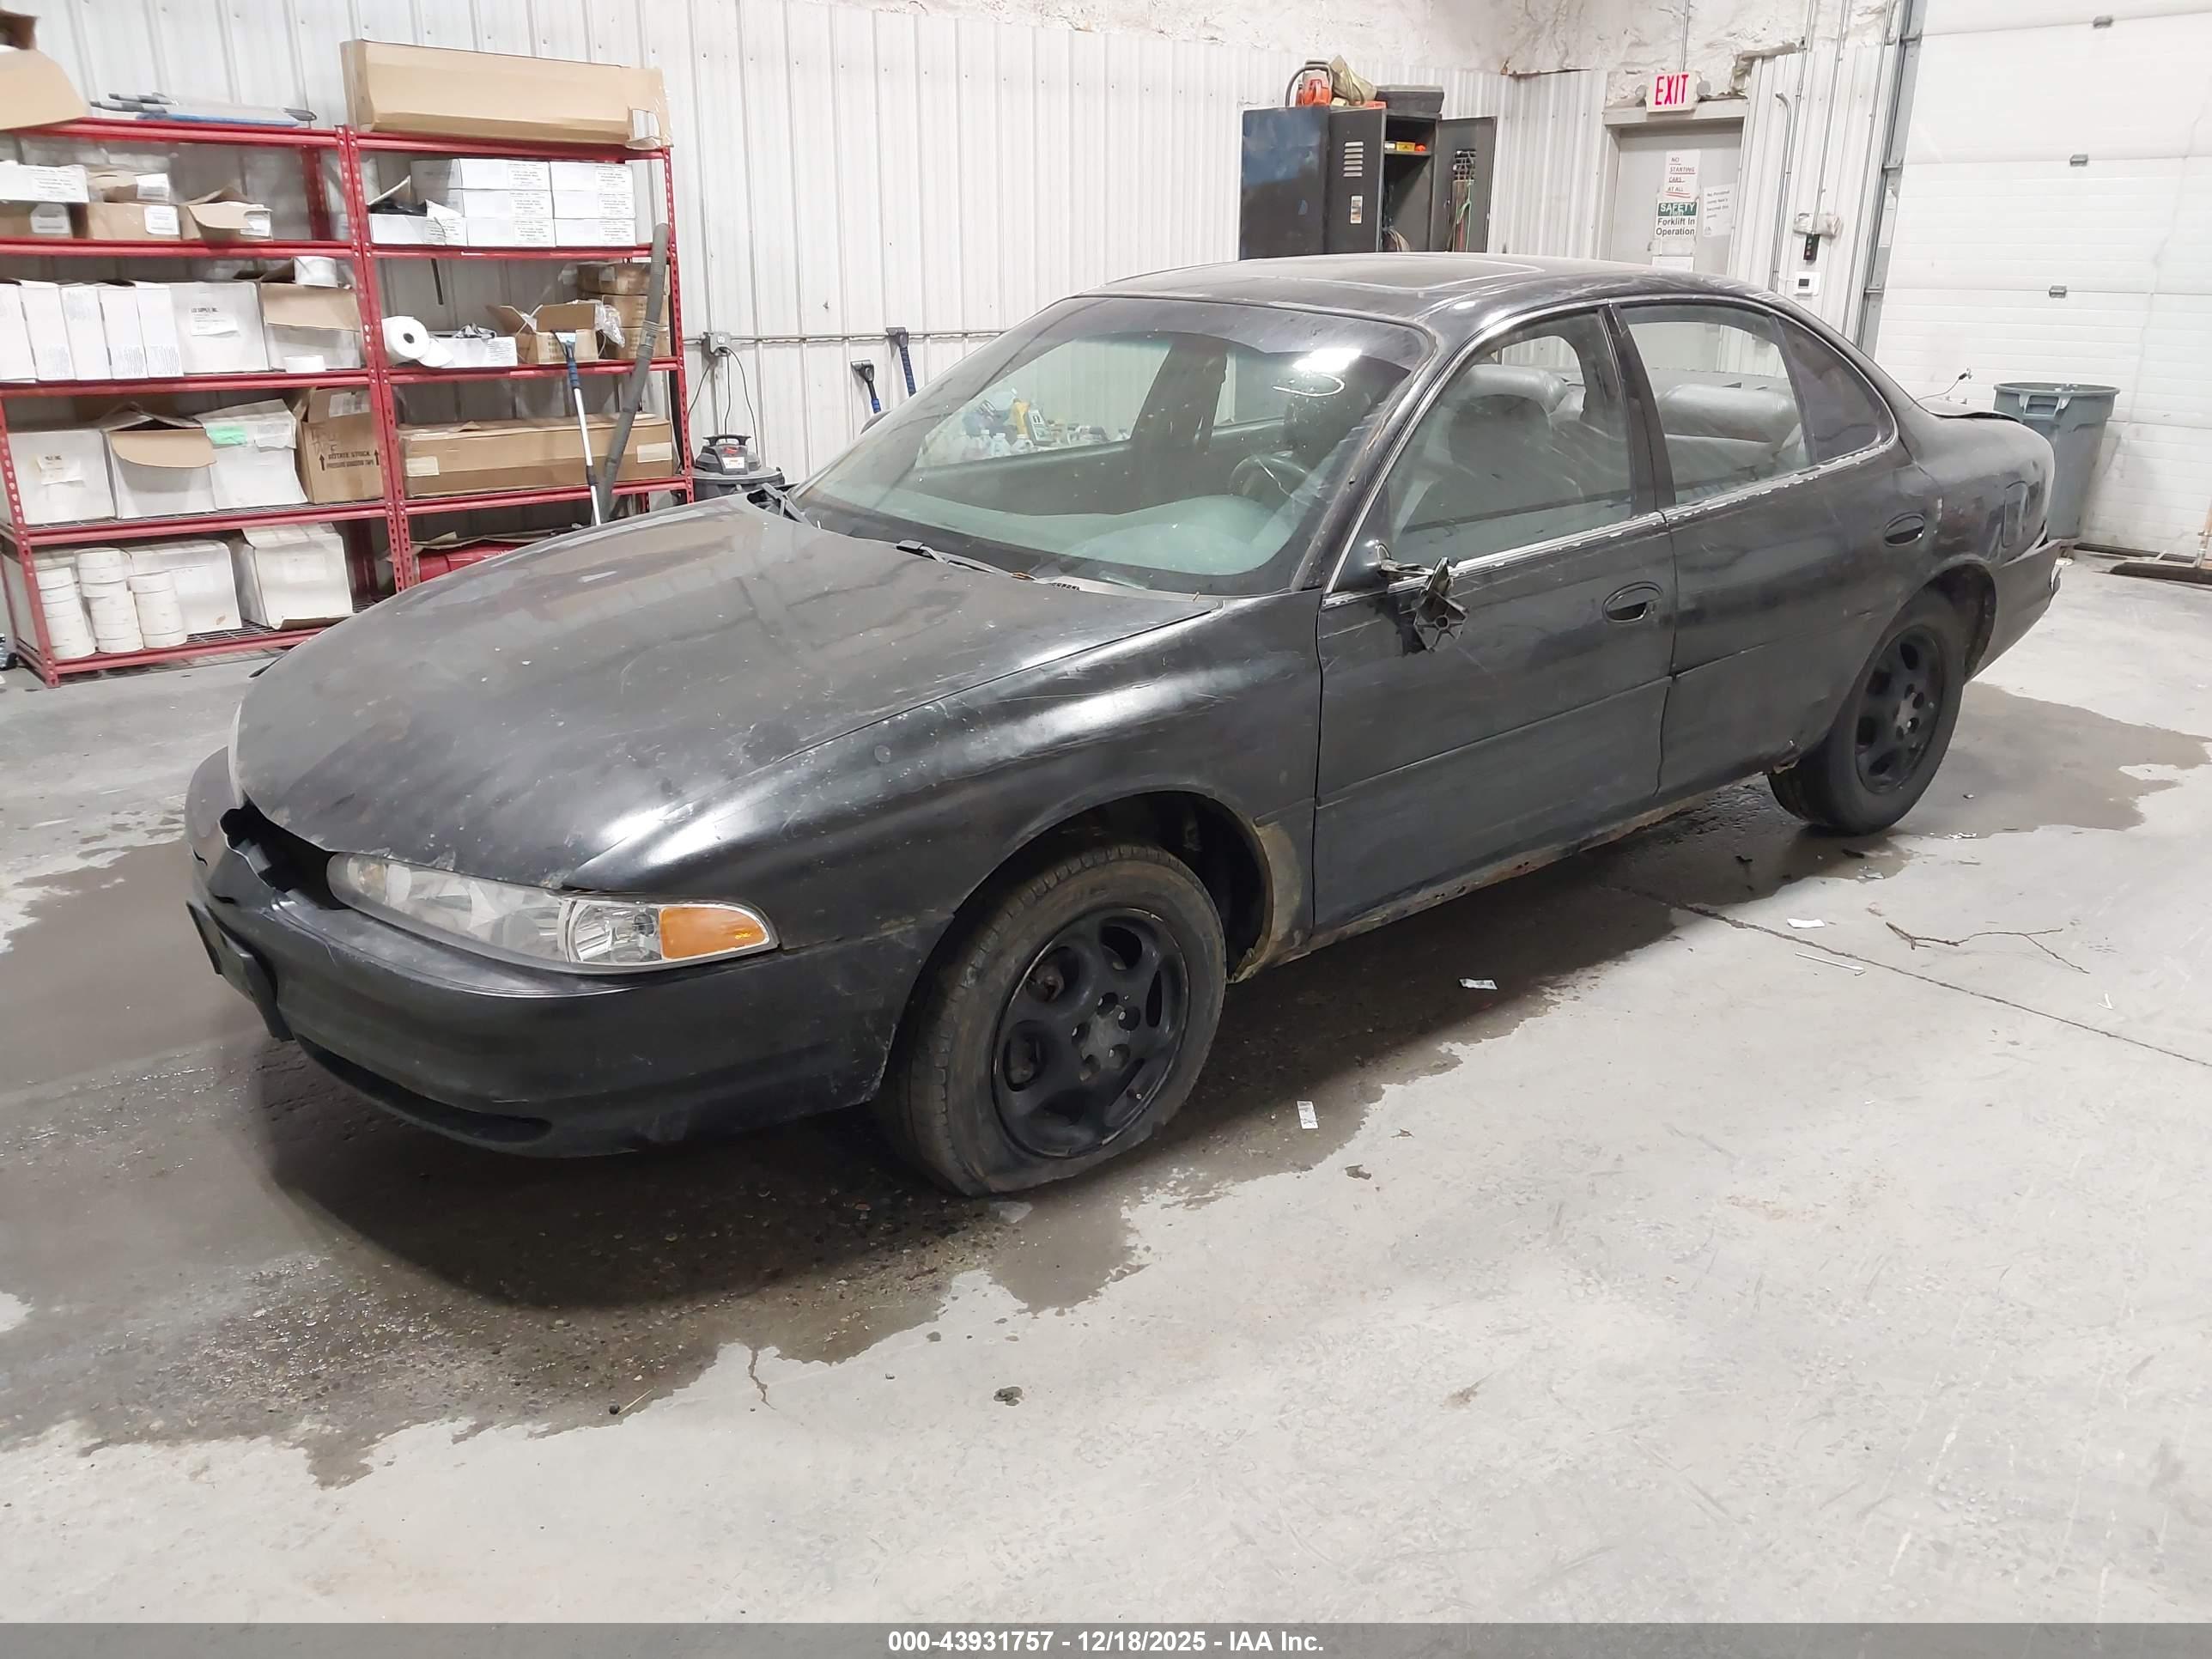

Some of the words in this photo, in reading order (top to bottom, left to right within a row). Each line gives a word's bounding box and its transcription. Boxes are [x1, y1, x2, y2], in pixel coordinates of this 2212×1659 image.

[1655, 74, 1689, 105] EXIT
[1660, 203, 1696, 212] SAFETY
[1656, 227, 1695, 237] Operation
